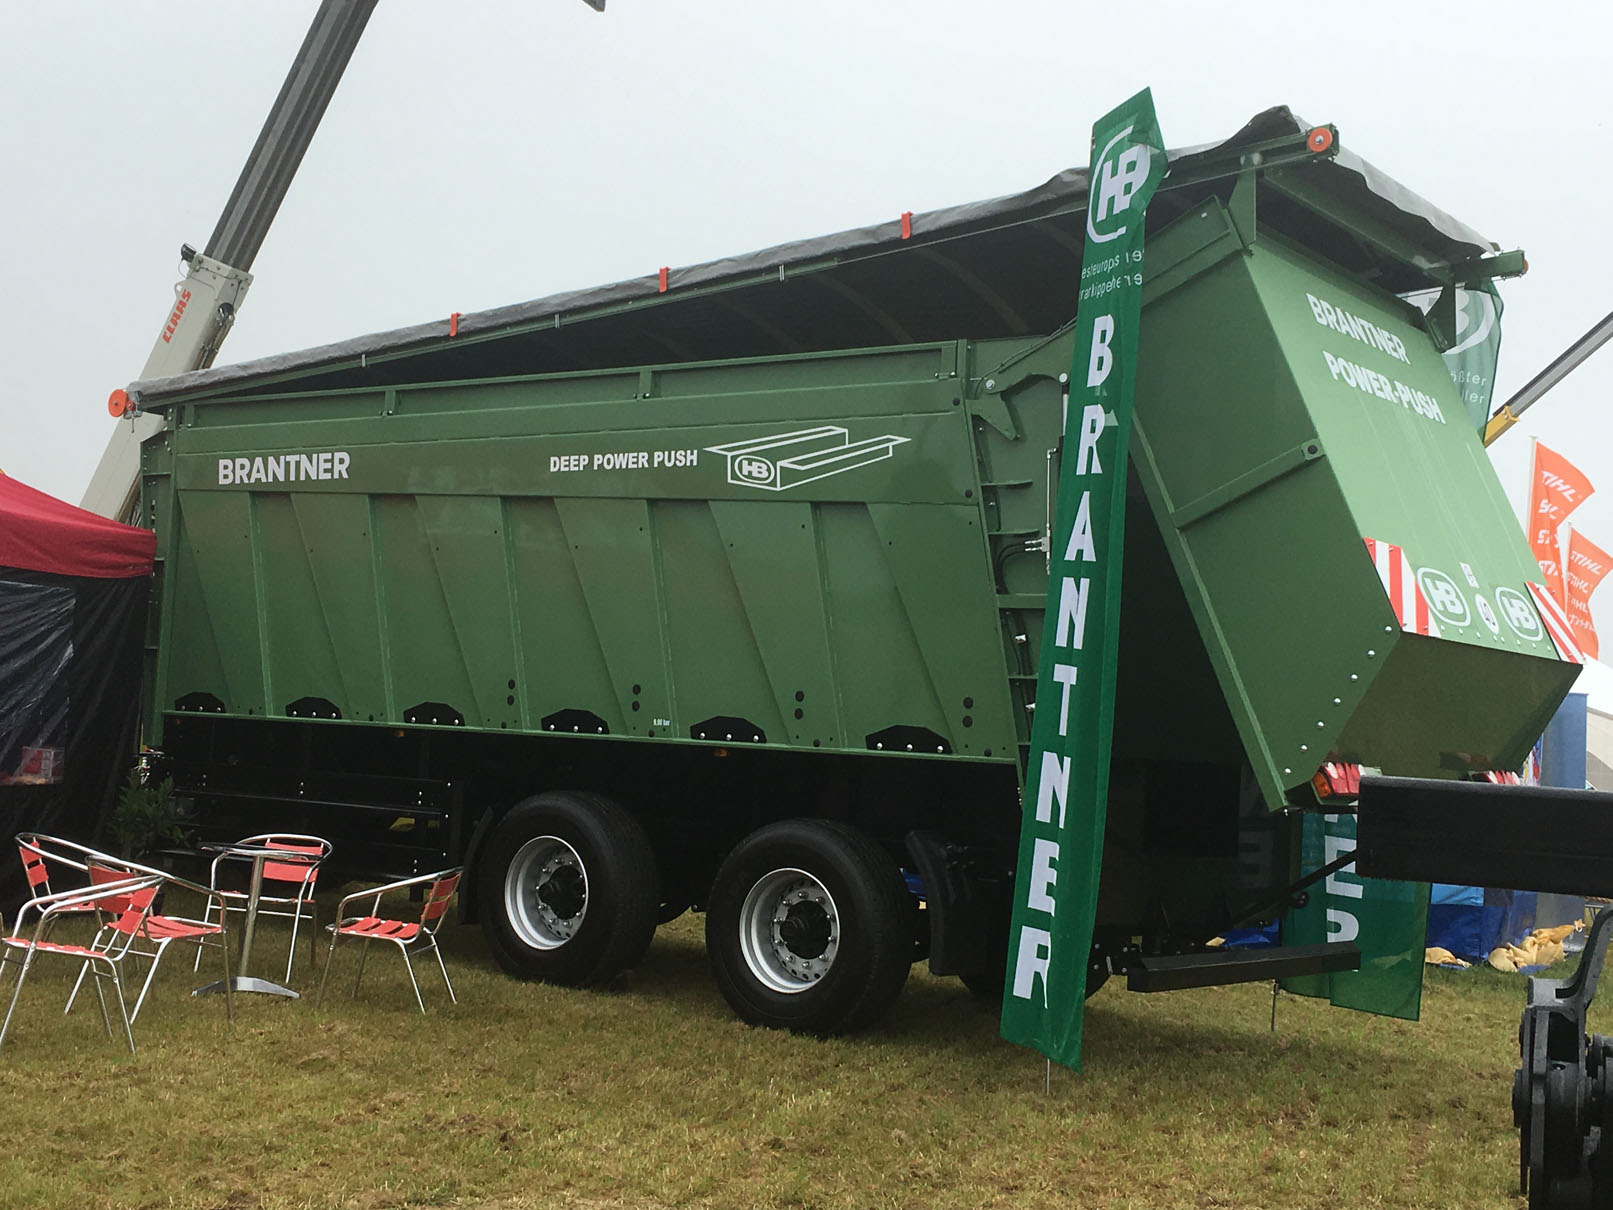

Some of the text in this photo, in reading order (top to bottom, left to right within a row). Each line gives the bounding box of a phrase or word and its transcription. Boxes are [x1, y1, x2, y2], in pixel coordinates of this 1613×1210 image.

[162, 288, 191, 344] CLAAS
[1306, 293, 1411, 365] BRANTNER
[1323, 351, 1446, 424] POWER-PUSH
[218, 451, 351, 485] BRANTNER
[550, 450, 698, 472] DEEP POWER PUSH
[1542, 470, 1577, 502] TIHL
[1013, 314, 1115, 1008] BRANTNER
